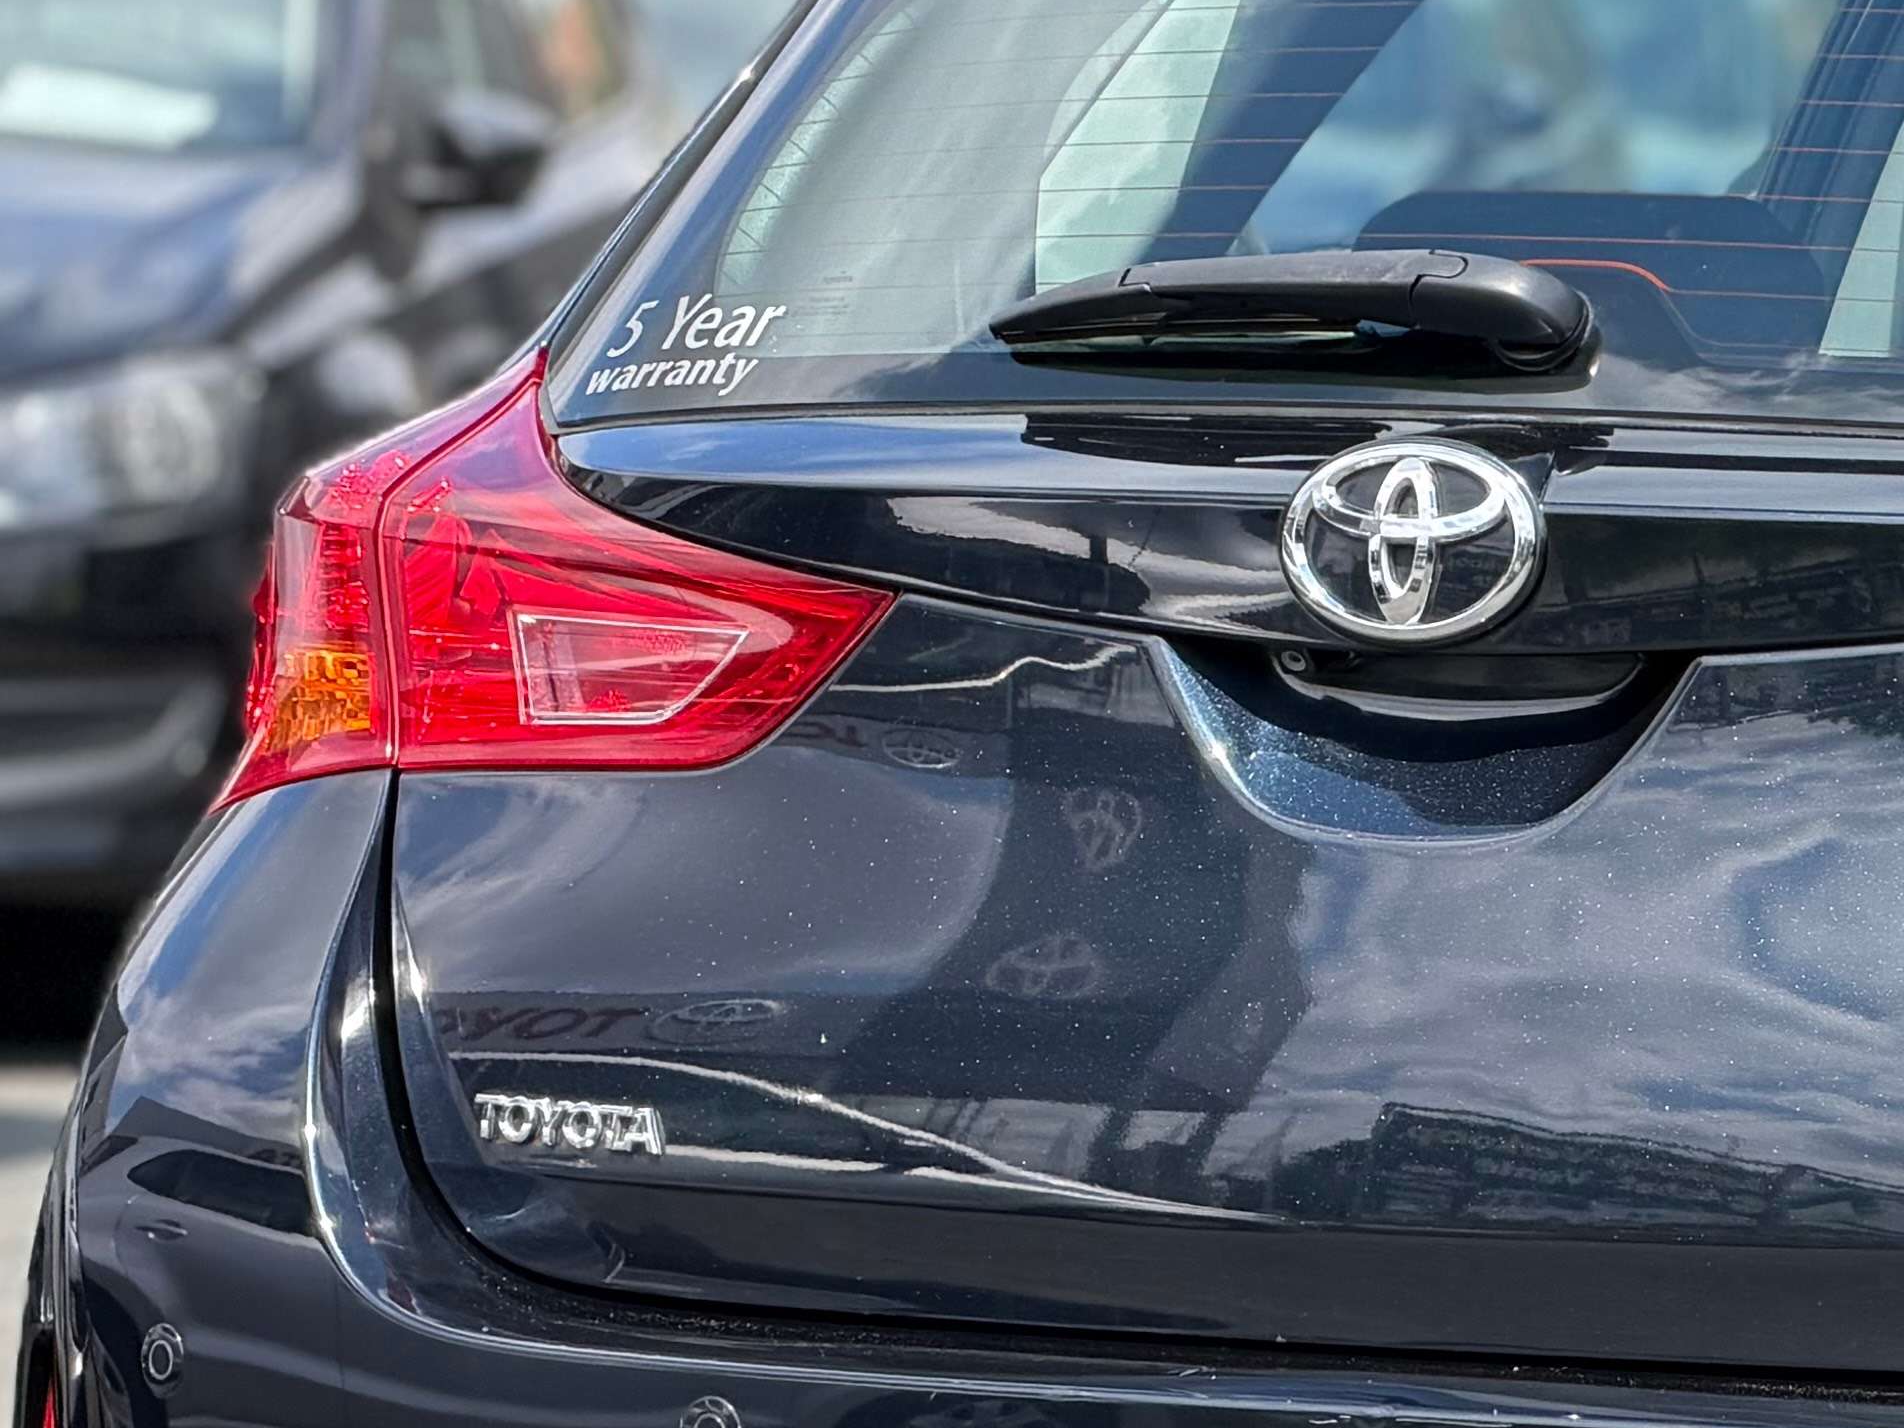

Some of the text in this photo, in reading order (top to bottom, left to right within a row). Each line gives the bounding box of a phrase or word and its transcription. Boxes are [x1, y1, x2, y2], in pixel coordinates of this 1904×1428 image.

[607, 293, 786, 358] 5 Year
[585, 353, 759, 396] warranty
[474, 1093, 664, 1155] TOYOTA
